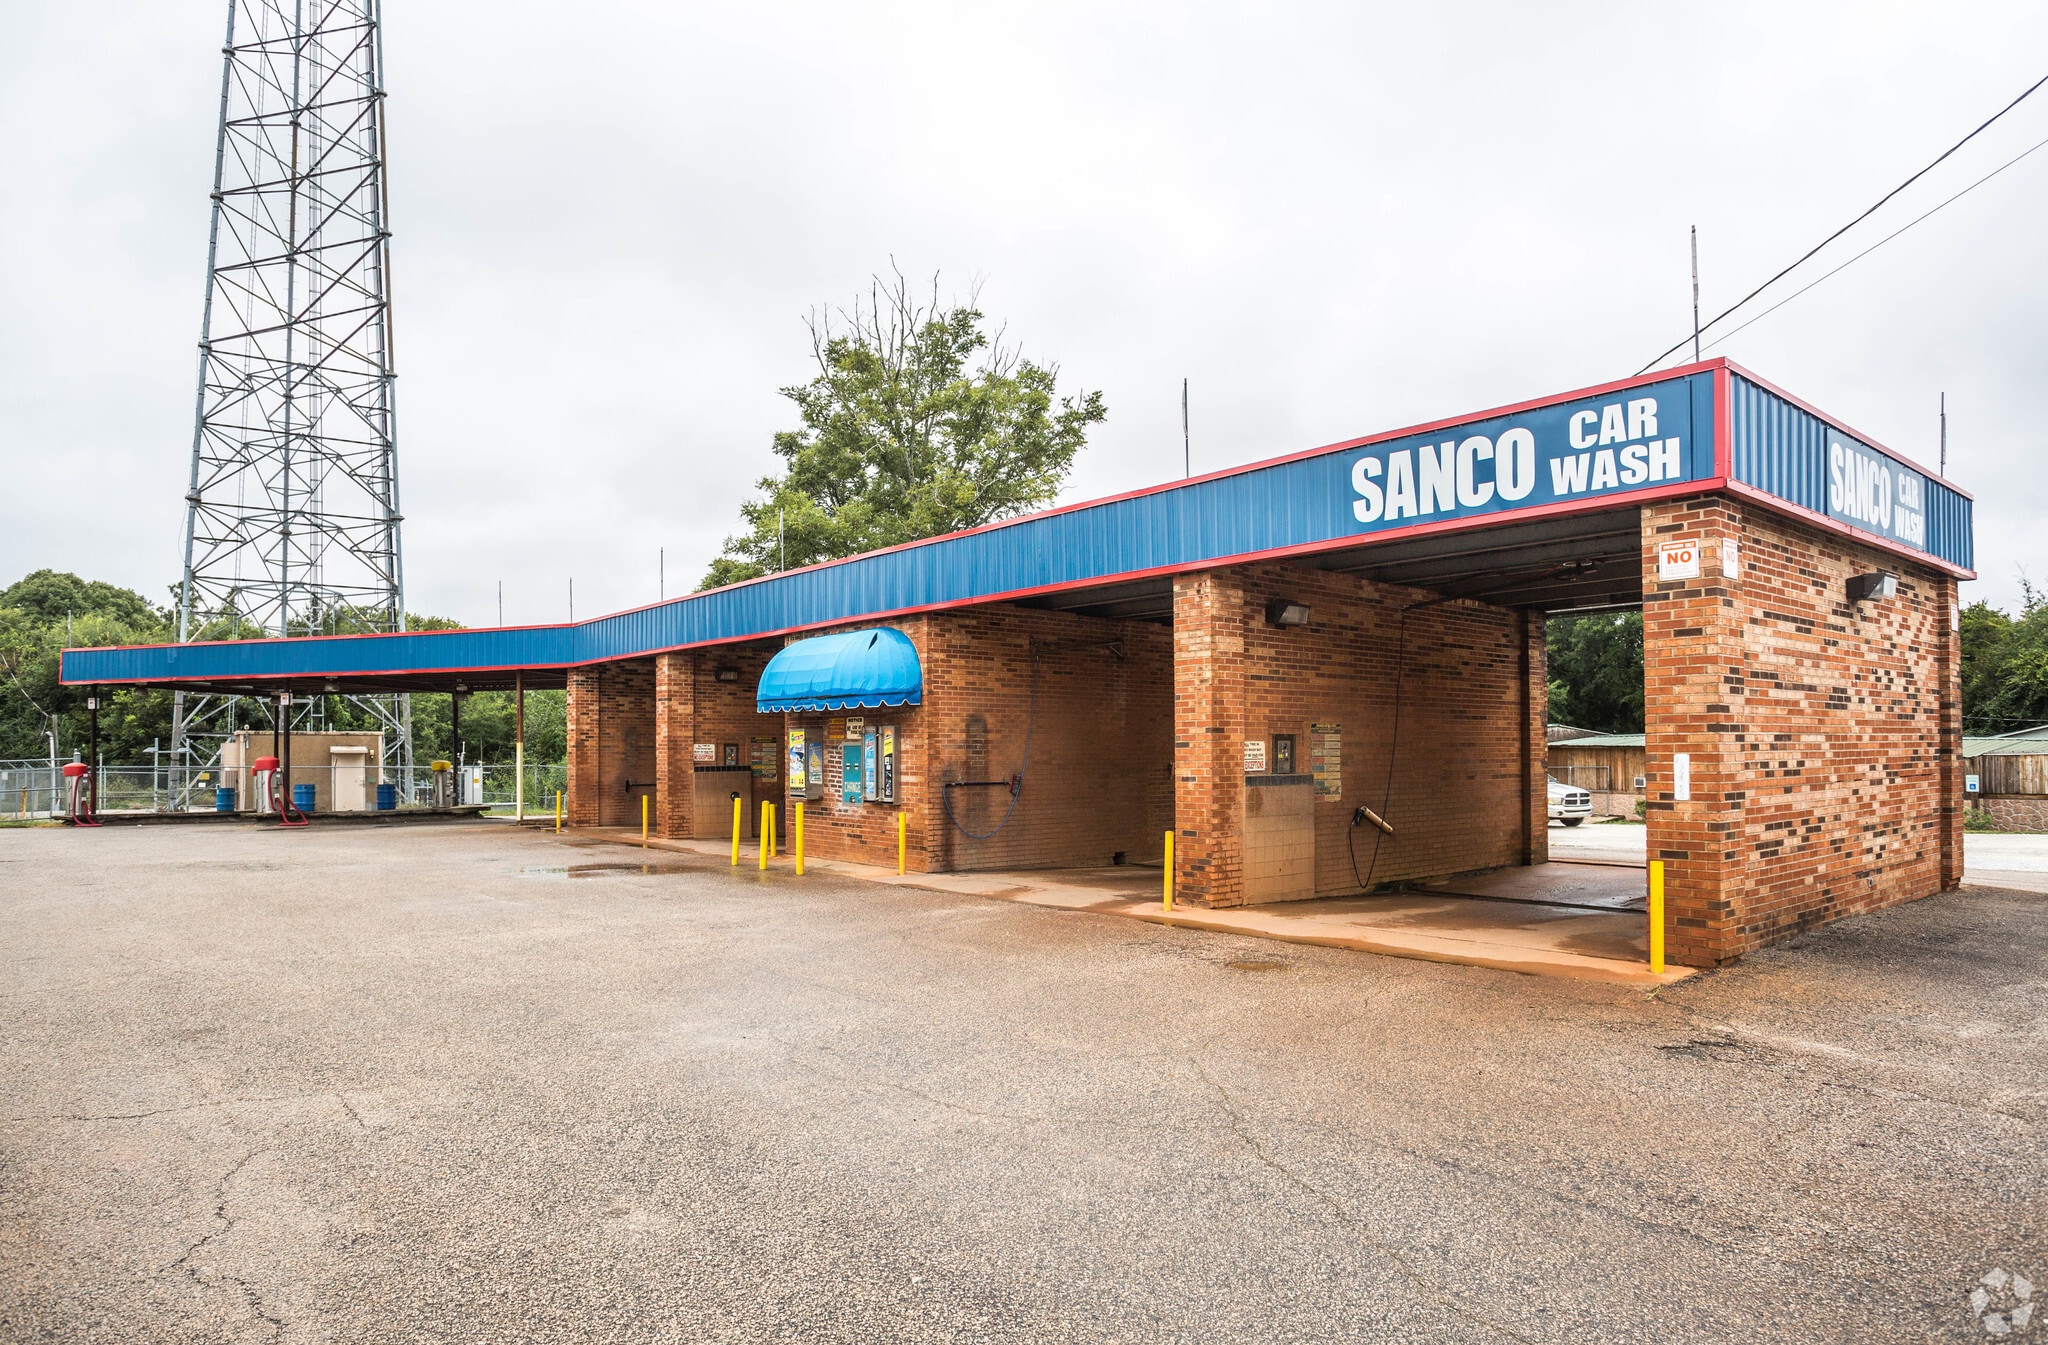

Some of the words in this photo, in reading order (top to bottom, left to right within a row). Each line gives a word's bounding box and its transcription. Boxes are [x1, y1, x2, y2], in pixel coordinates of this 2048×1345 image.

[1569, 397, 1658, 449] CAR
[1352, 427, 1536, 523] SANCO
[1550, 437, 1681, 496] WASH
[1830, 442, 1892, 530] SANCO
[1898, 472, 1919, 510] CAR
[1894, 504, 1924, 546] WASH
[1667, 551, 1692, 564] NO
[1726, 549, 1735, 563] NO
